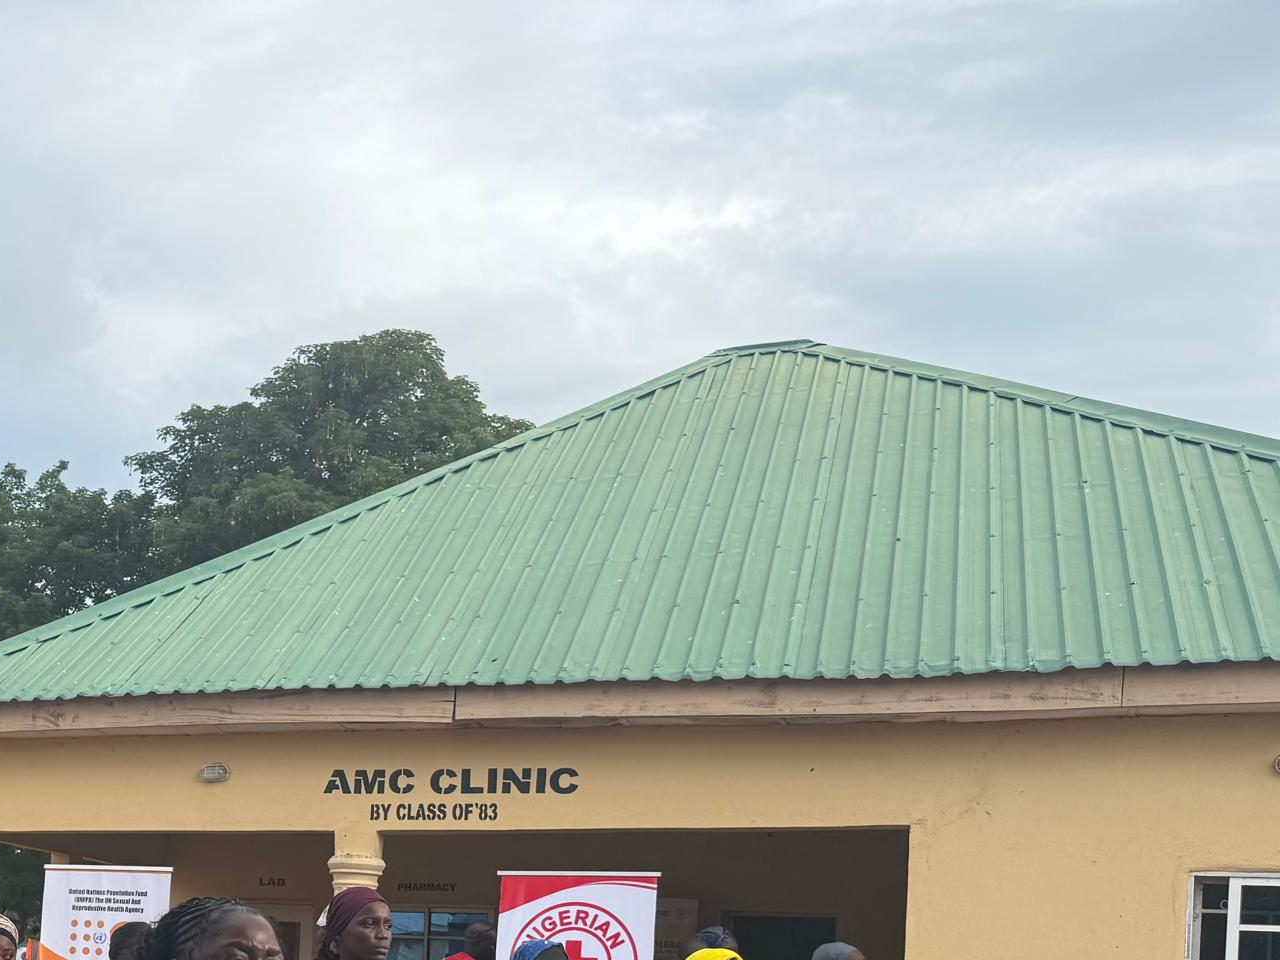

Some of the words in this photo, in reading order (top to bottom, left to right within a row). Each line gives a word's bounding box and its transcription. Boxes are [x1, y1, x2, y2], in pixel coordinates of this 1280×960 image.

[323, 768, 415, 795] AMC
[429, 767, 579, 795] CLINIC
[370, 803, 392, 821] BY
[396, 803, 447, 821] CLASS
[259, 878, 286, 887] LAB
[397, 882, 457, 892] PHARMACY
